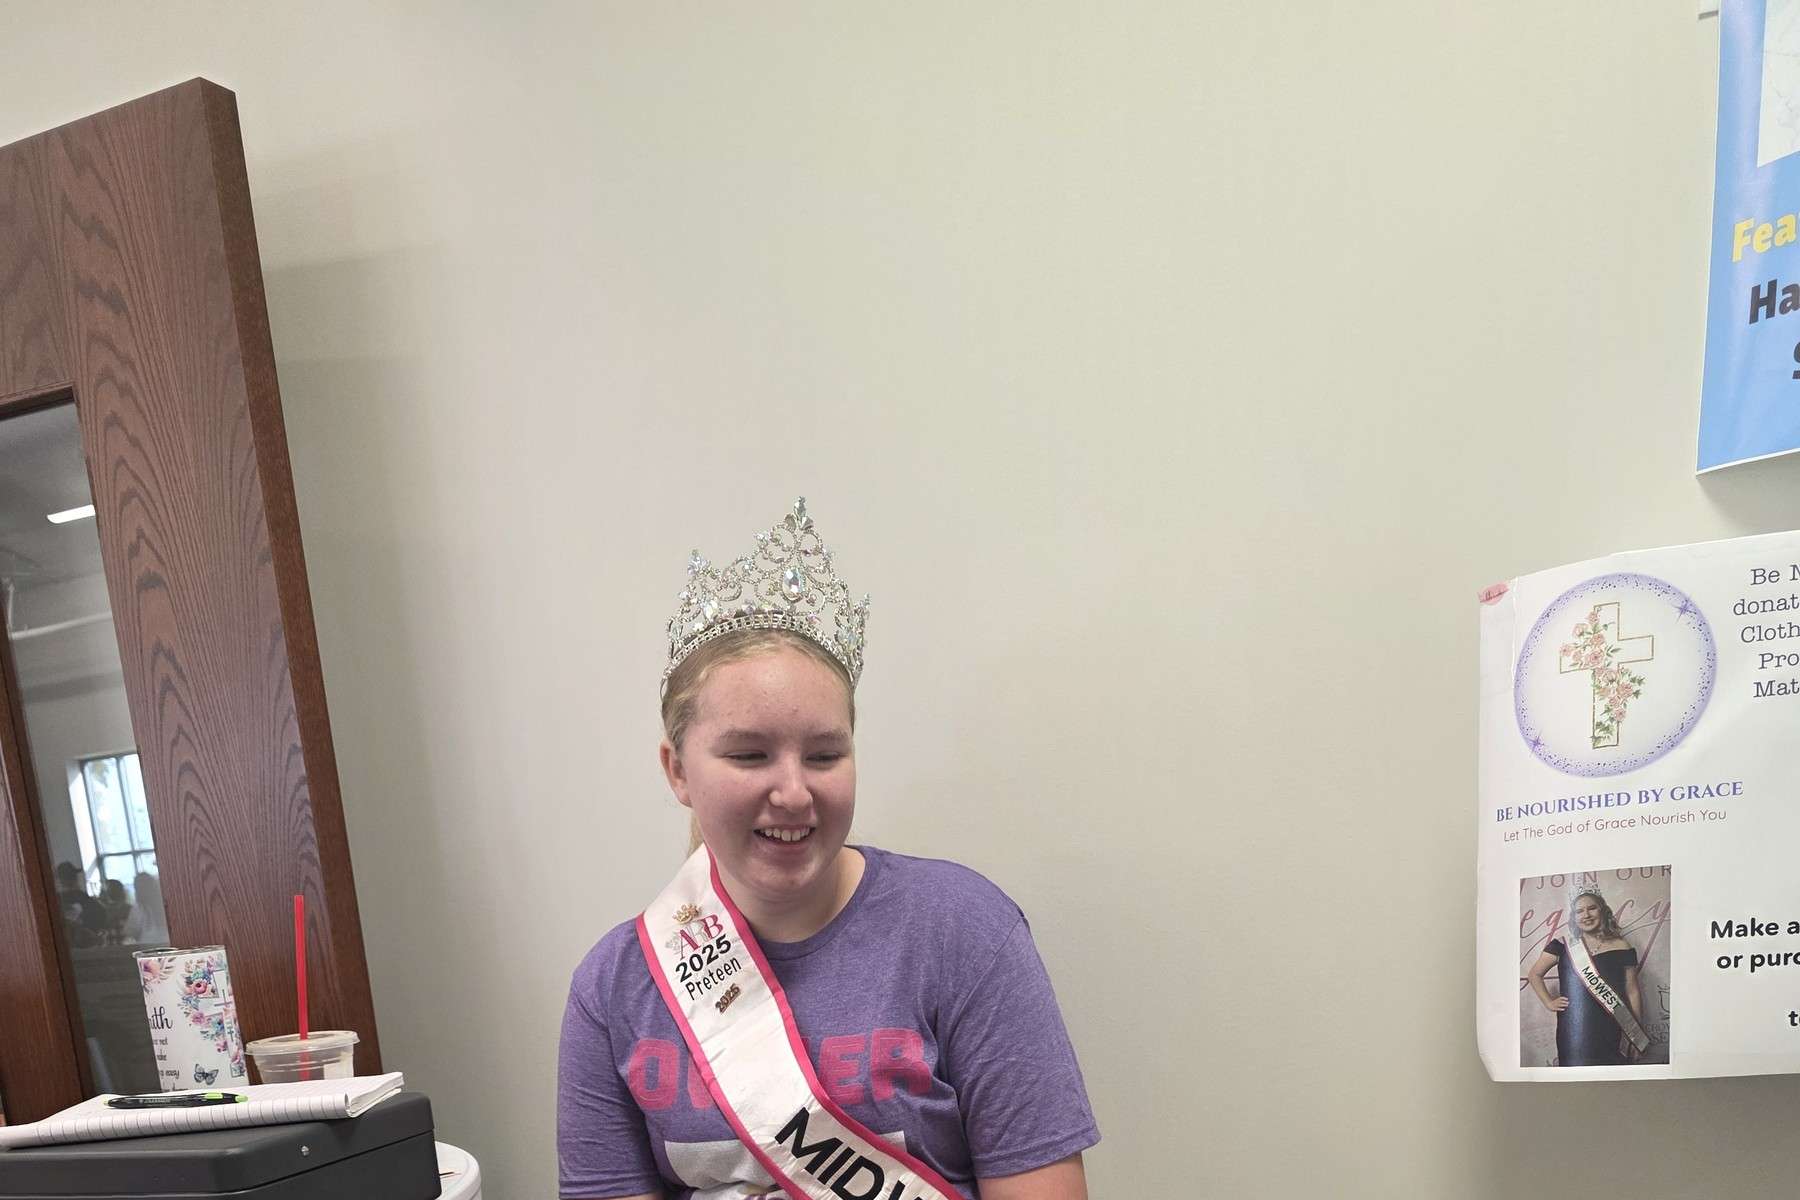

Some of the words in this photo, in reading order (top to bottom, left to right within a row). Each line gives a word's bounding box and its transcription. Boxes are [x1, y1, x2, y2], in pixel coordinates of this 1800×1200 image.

[1732, 212, 1800, 263] Fea
[1750, 567, 1781, 586] Be
[1733, 593, 1800, 616] donat
[1740, 621, 1800, 643] Cloth
[1758, 652, 1800, 670] Pro
[1753, 678, 1800, 698] Mat
[1496, 806, 1514, 822] BE
[1517, 791, 1632, 819] NOURISHED
[1638, 787, 1664, 805] BY
[1670, 780, 1745, 802] GRACE
[1503, 831, 1520, 842] Let
[1522, 826, 1544, 840] The
[1546, 822, 1573, 837] God
[1576, 819, 1593, 833] of
[1594, 818, 1637, 831] Grace
[1640, 810, 1696, 826] Nourish
[1699, 808, 1727, 821] You
[1710, 917, 1780, 939] Make
[675, 933, 732, 983] 2025
[1716, 954, 1744, 969] or
[684, 956, 743, 1001] Preteen
[1581, 965, 1623, 1011] MIDWEST
[714, 982, 742, 1015] 2025
[627, 1027, 933, 1112] OER
